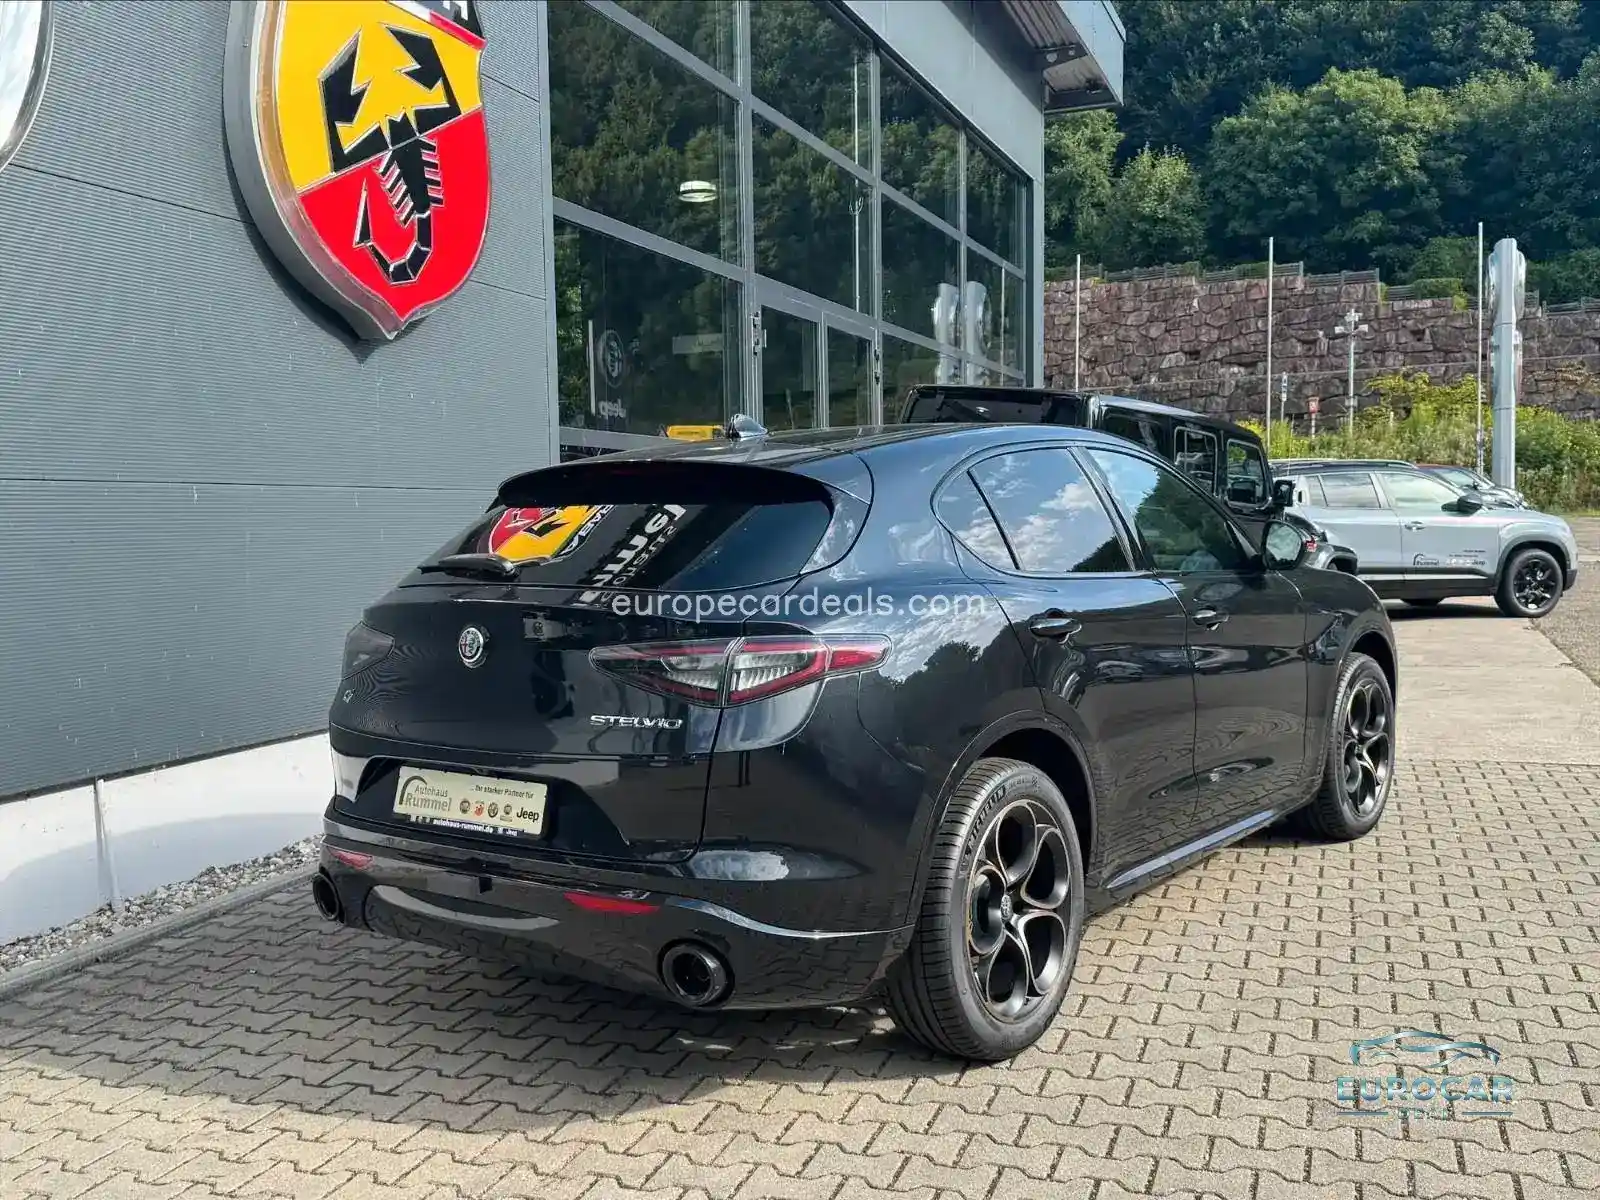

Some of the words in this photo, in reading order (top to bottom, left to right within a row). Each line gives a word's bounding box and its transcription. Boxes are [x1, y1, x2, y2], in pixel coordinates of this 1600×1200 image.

[590, 714, 683, 730] STELVIO
[415, 785, 448, 797] Autohaus
[405, 792, 452, 811] Rummel
[516, 807, 540, 822] Jeep
